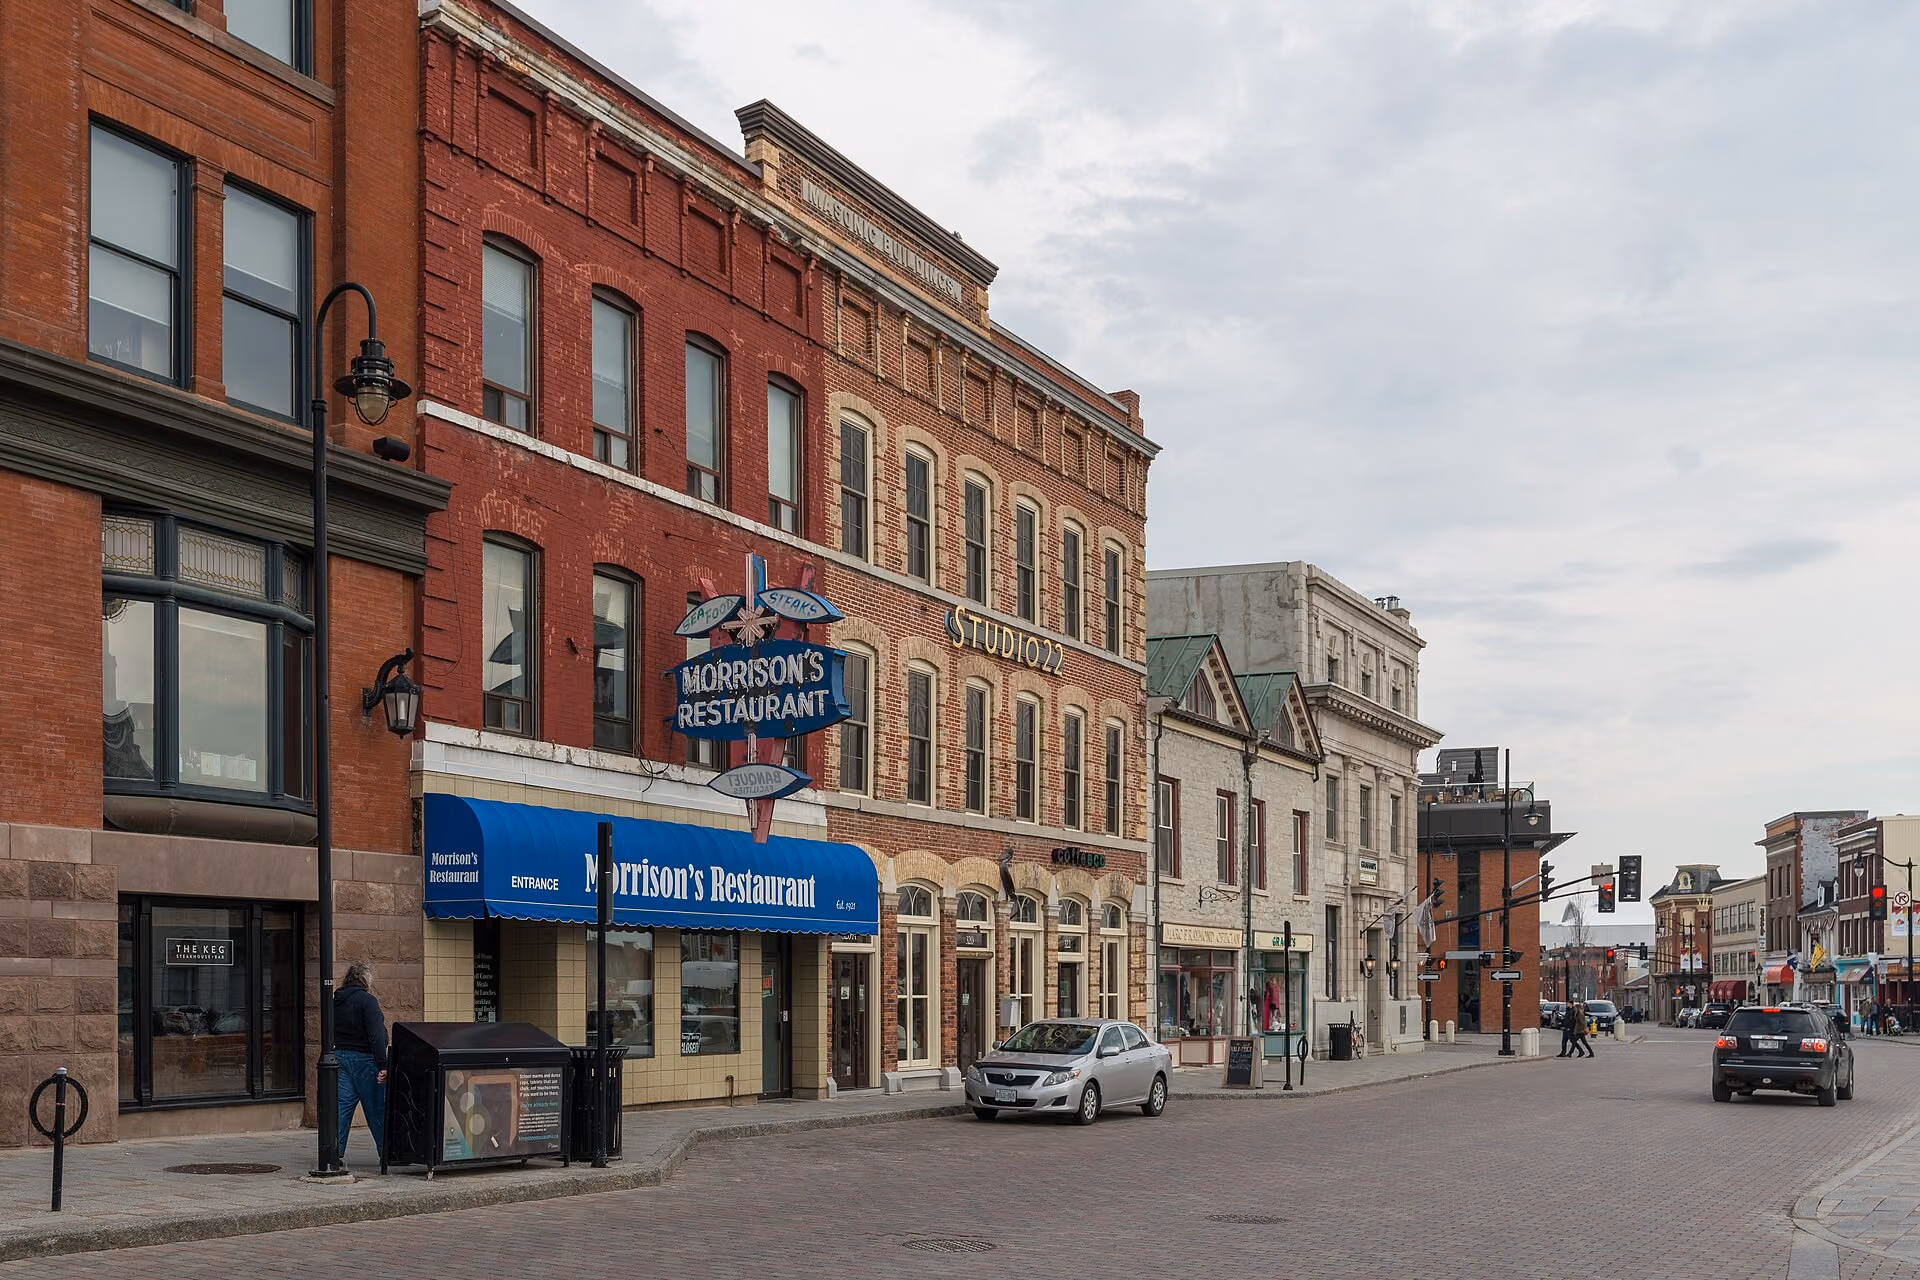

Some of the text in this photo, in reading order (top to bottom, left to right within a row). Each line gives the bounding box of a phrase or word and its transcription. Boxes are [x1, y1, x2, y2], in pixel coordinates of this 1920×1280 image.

[807, 180, 955, 297] MASONIC BUILDINGS
[769, 592, 817, 617] STEAKS
[682, 649, 825, 695] MORRISON'S
[677, 689, 830, 729] RESTAURANT
[431, 851, 478, 866] Morrison's
[429, 869, 480, 883] Restaurant
[511, 875, 559, 891] ENTRANCE
[710, 865, 816, 908] Restaurant
[176, 944, 225, 954] THE KEG
